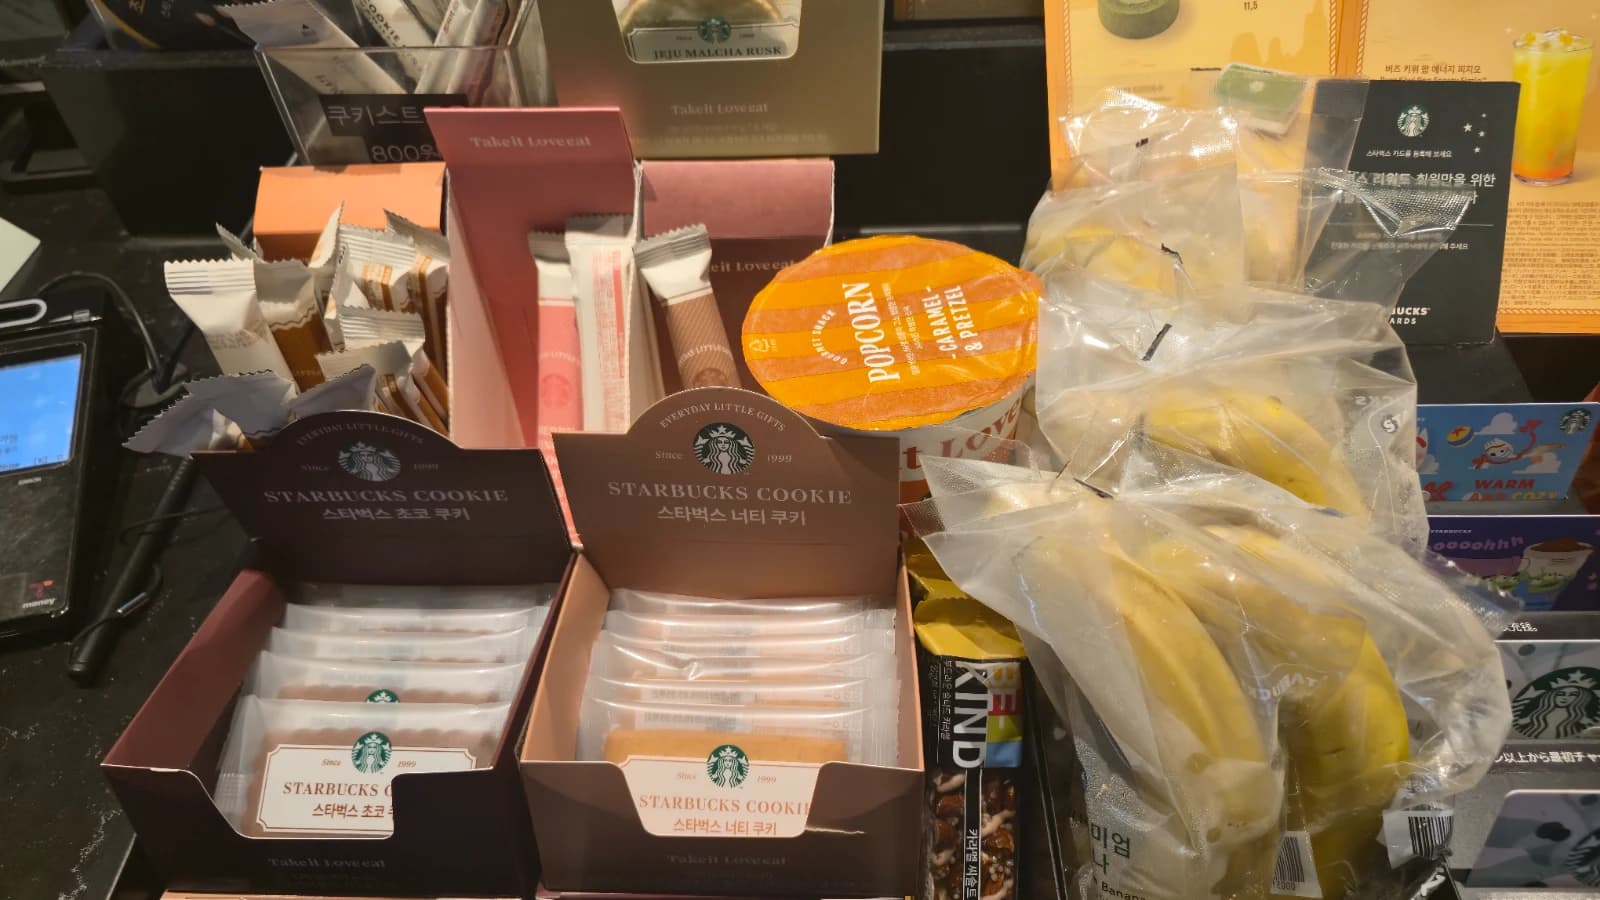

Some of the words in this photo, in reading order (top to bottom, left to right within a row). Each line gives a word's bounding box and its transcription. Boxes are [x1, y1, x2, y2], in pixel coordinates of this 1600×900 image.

[654, 49, 682, 60] JEJU
[685, 47, 743, 58] MALCHA
[745, 46, 782, 56] RUSK
[1470, 173, 1496, 188] 위한
[944, 285, 978, 340] PRETZEL
[842, 282, 900, 384] POPCORN
[660, 402, 712, 429] EVERYDAY
[714, 402, 754, 417] LITTLE
[757, 409, 787, 432] GIFTS
[655, 450, 684, 460] Since
[767, 453, 793, 463] 1999
[607, 481, 749, 501] STARBUCKS
[756, 487, 852, 505] COOKIE
[1474, 479, 1536, 490] WARM
[263, 489, 407, 504] STARBUCKS
[413, 489, 509, 502] COOKIE
[322, 507, 395, 520] 스타벅스
[399, 508, 431, 520] 초코
[435, 507, 471, 520] 쿠키
[657, 505, 727, 522] 스타벅스
[731, 508, 766, 526] 너티
[770, 510, 806, 526] 쿠키
[953, 661, 990, 768] KIND
[283, 781, 379, 797] STARBUCKS
[312, 803, 358, 819] 스타벅스
[361, 804, 385, 818] 초코
[639, 795, 741, 812] STARBUCKS
[673, 818, 721, 833] 스타벅스
[725, 820, 749, 836] 너티
[753, 821, 777, 836] 쿠키
[966, 828, 978, 862] 카라멜
[965, 865, 978, 898] 씨솔트
